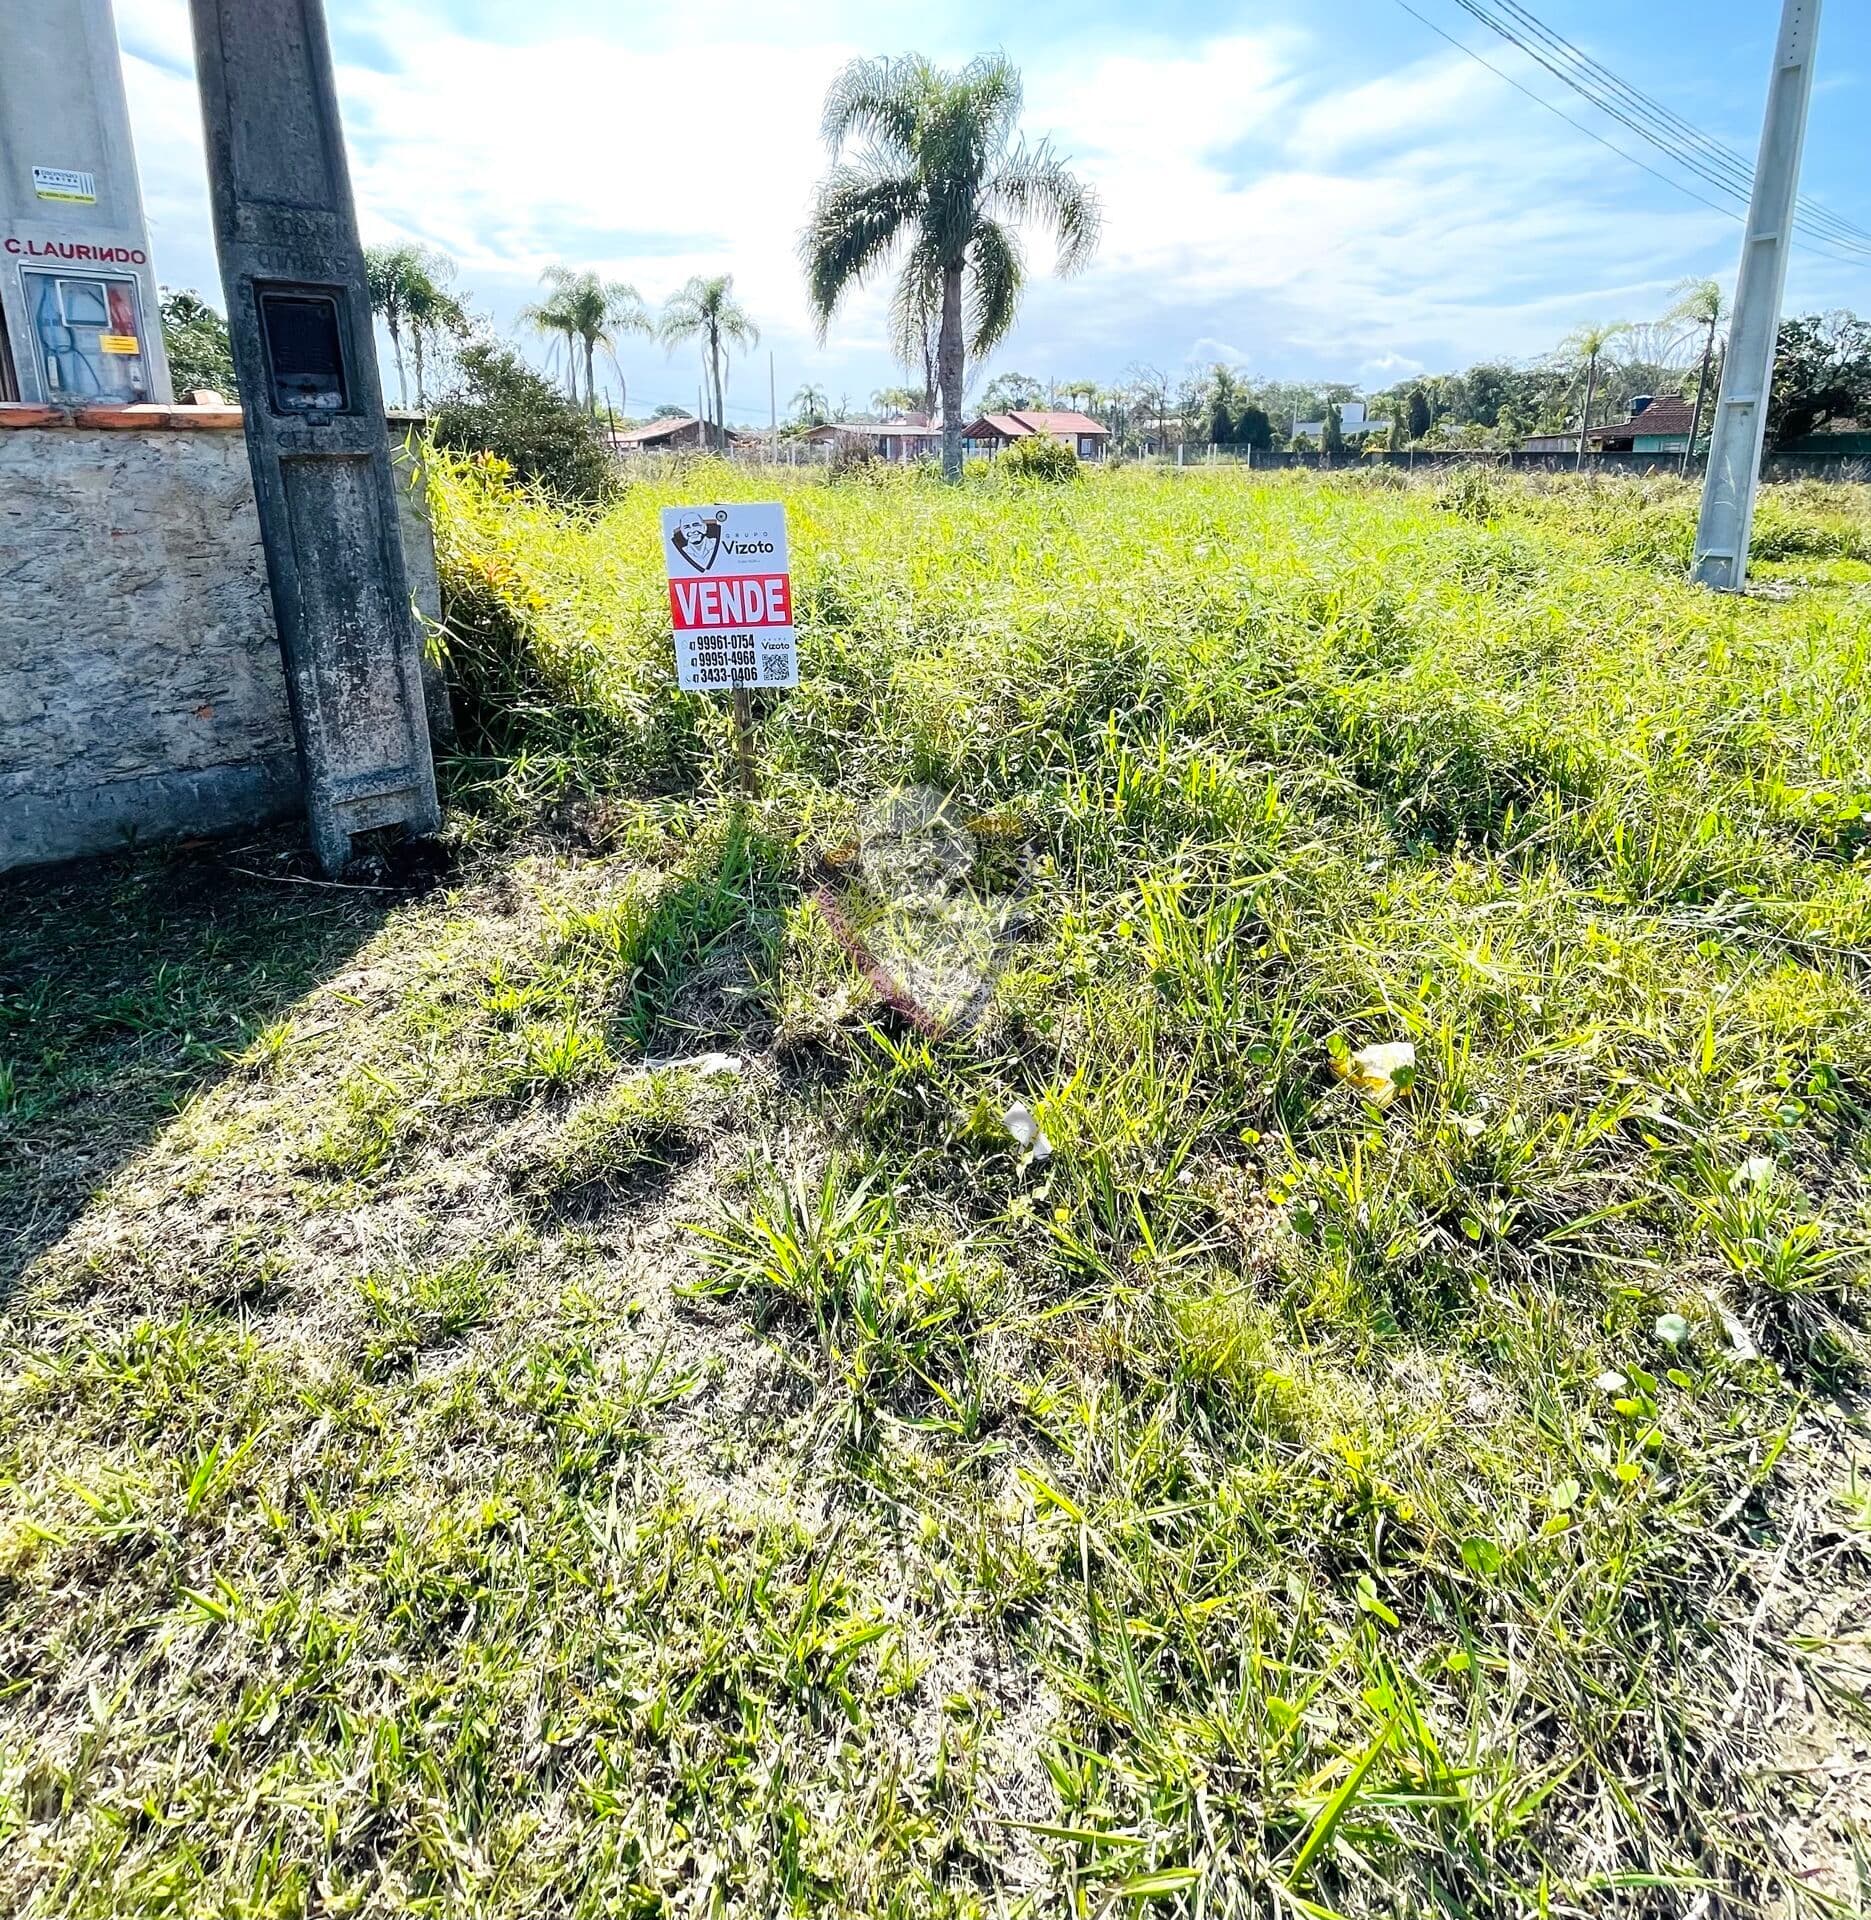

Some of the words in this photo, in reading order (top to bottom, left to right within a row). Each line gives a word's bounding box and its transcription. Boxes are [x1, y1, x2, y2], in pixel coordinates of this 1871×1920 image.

[725, 531, 768, 539] GRUPO
[721, 540, 774, 555] Vizoto
[675, 578, 786, 625] VENDE
[697, 634, 755, 650] 99961-0754
[761, 642, 790, 650] Vizoto
[698, 651, 756, 667] 99951-4968
[700, 667, 758, 683] 3433-0406
